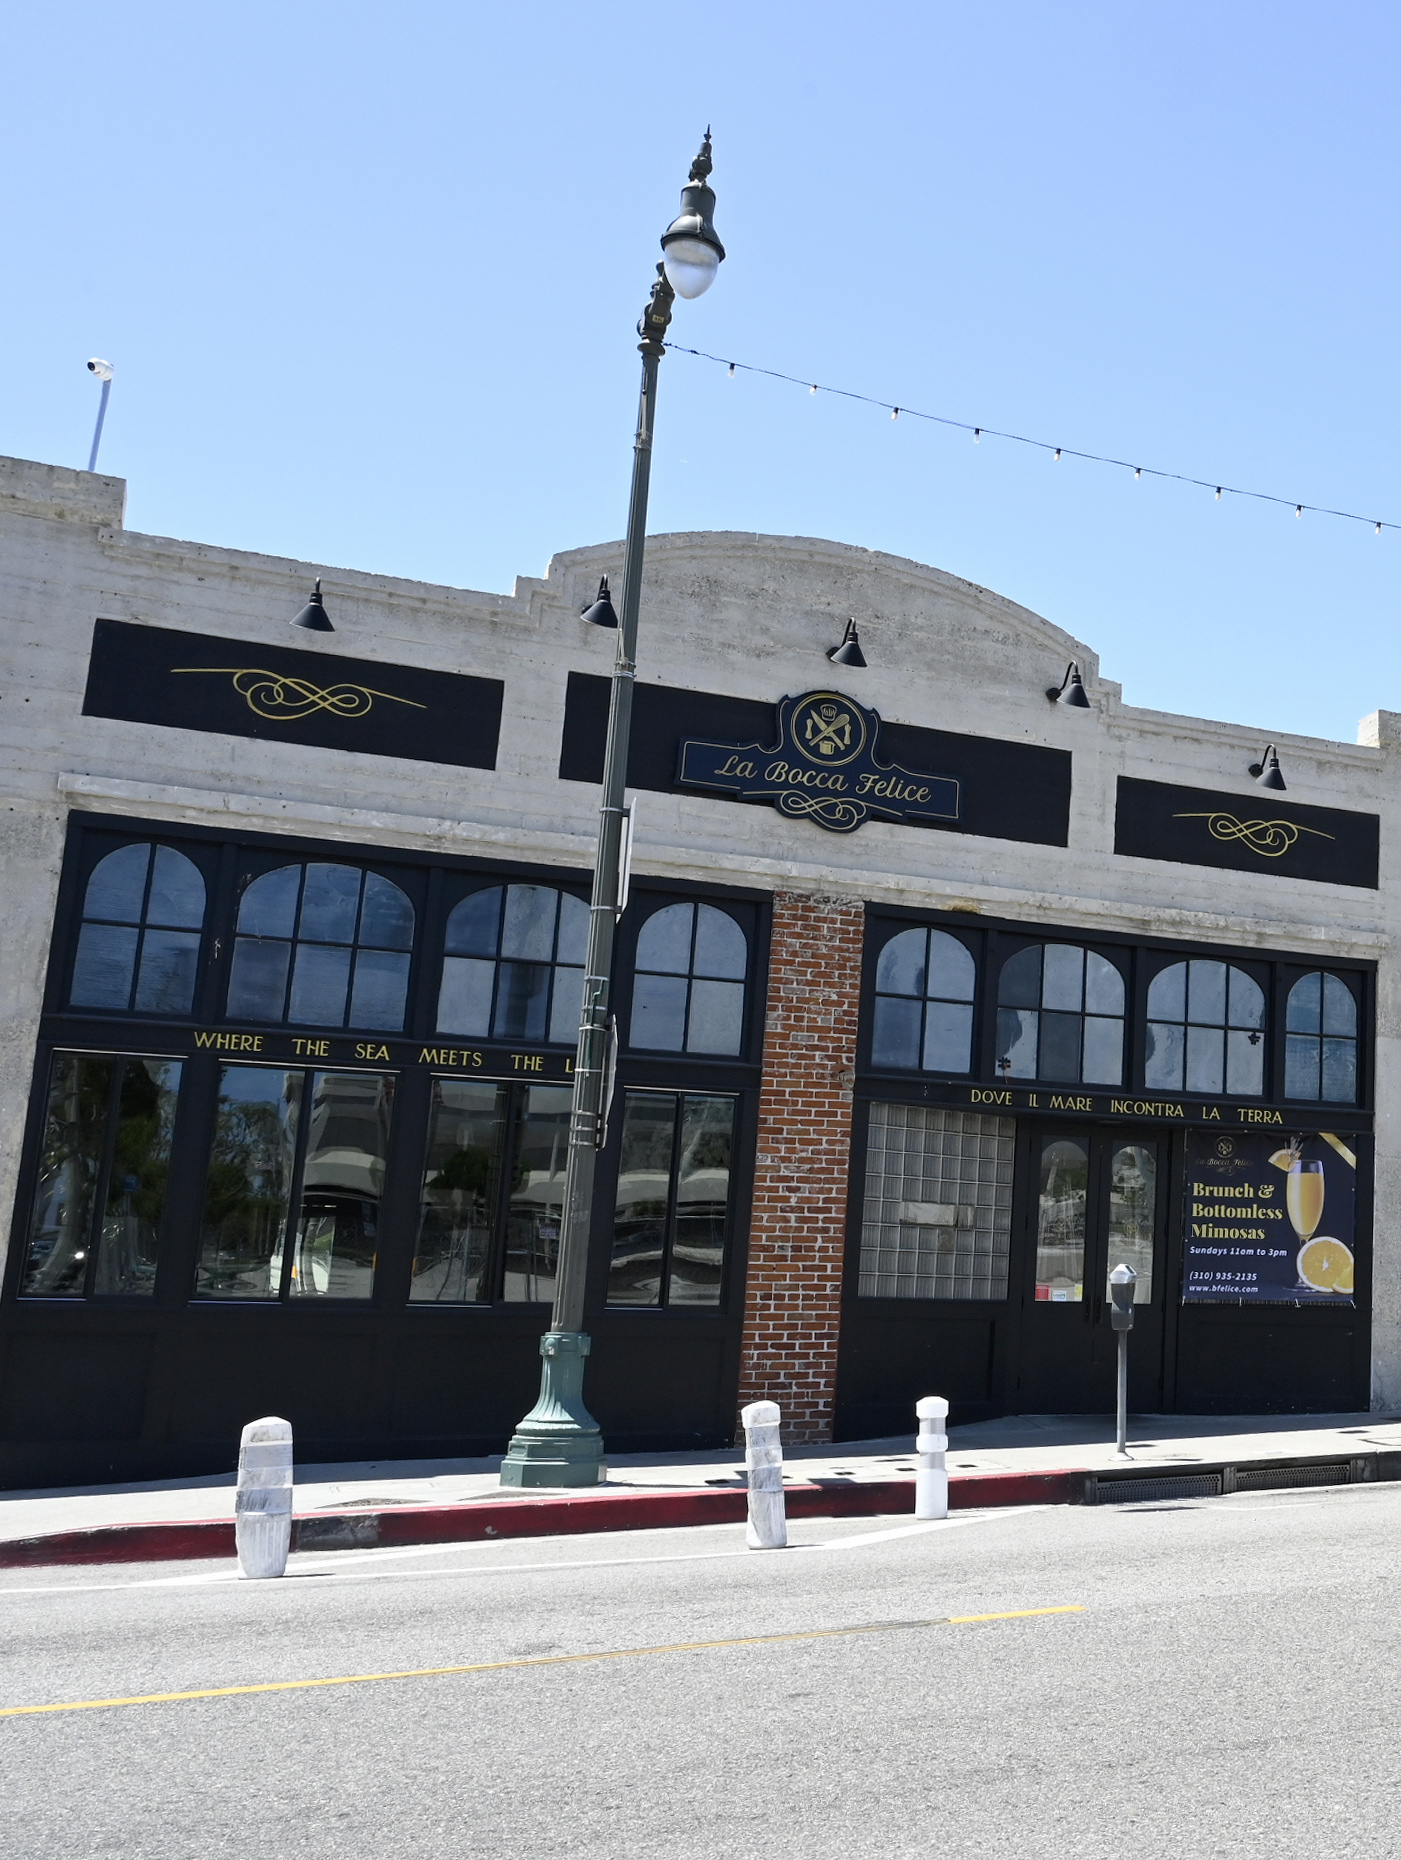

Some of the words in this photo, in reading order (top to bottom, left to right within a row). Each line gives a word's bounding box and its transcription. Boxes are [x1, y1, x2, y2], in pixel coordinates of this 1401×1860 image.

[714, 755, 757, 779] La
[764, 761, 849, 791] Bocca
[855, 773, 932, 803] Felice
[193, 1031, 264, 1051] WHERE
[291, 1038, 330, 1057] THE
[354, 1043, 390, 1061] SEA
[418, 1048, 483, 1067] MEETS
[510, 1054, 544, 1072] THE
[971, 1089, 1013, 1106] DOVE
[1029, 1093, 1039, 1108] IL
[1049, 1095, 1093, 1111] MARE
[1110, 1099, 1184, 1118] INCONTRA
[1202, 1106, 1221, 1120] LA
[1237, 1108, 1283, 1124] TERRA
[1192, 1182, 1254, 1198] Brunch
[1258, 1183, 1275, 1199] &
[1191, 1203, 1283, 1220] Bottomless
[1190, 1223, 1266, 1240] Mimosas
[1189, 1245, 1228, 1256] Sundays
[1230, 1247, 1254, 1256] 11am
[1256, 1247, 1266, 1256] to
[1267, 1248, 1288, 1257] 3pm
[1189, 1271, 1214, 1282] (310)
[1215, 1272, 1258, 1281] 935-2135
[1188, 1284, 1259, 1293] www.bfelice.com
